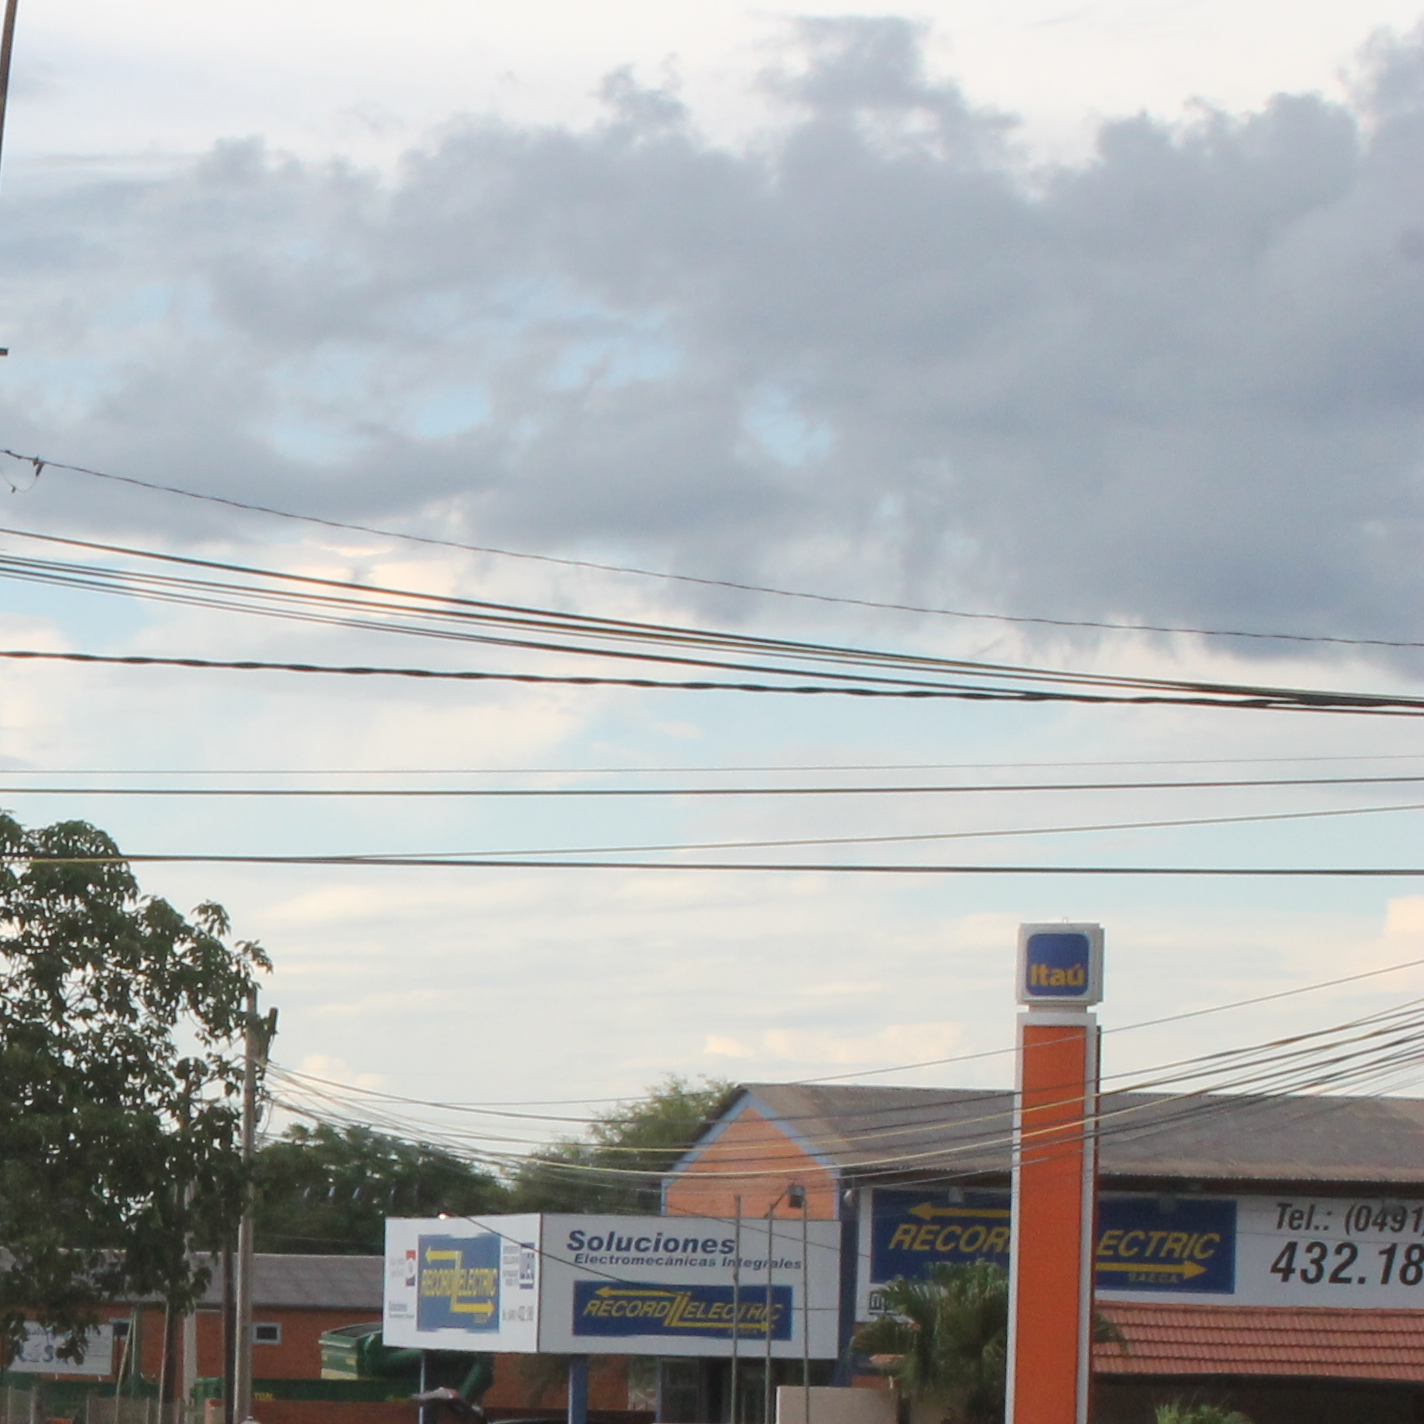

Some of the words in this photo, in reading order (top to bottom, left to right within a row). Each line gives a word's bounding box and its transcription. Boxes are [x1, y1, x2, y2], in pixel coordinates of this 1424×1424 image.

[1030, 963, 1085, 986] Itaú
[567, 1230, 737, 1255] Soluciones
[889, 1224, 1011, 1252] RECOR
[1096, 1230, 1221, 1259] ECTRIC
[574, 1252, 716, 1267] Electromecánicas
[722, 1257, 802, 1270] Integrales
[583, 1300, 670, 1318] RECORD
[684, 1302, 784, 1320] ELECTRIC
